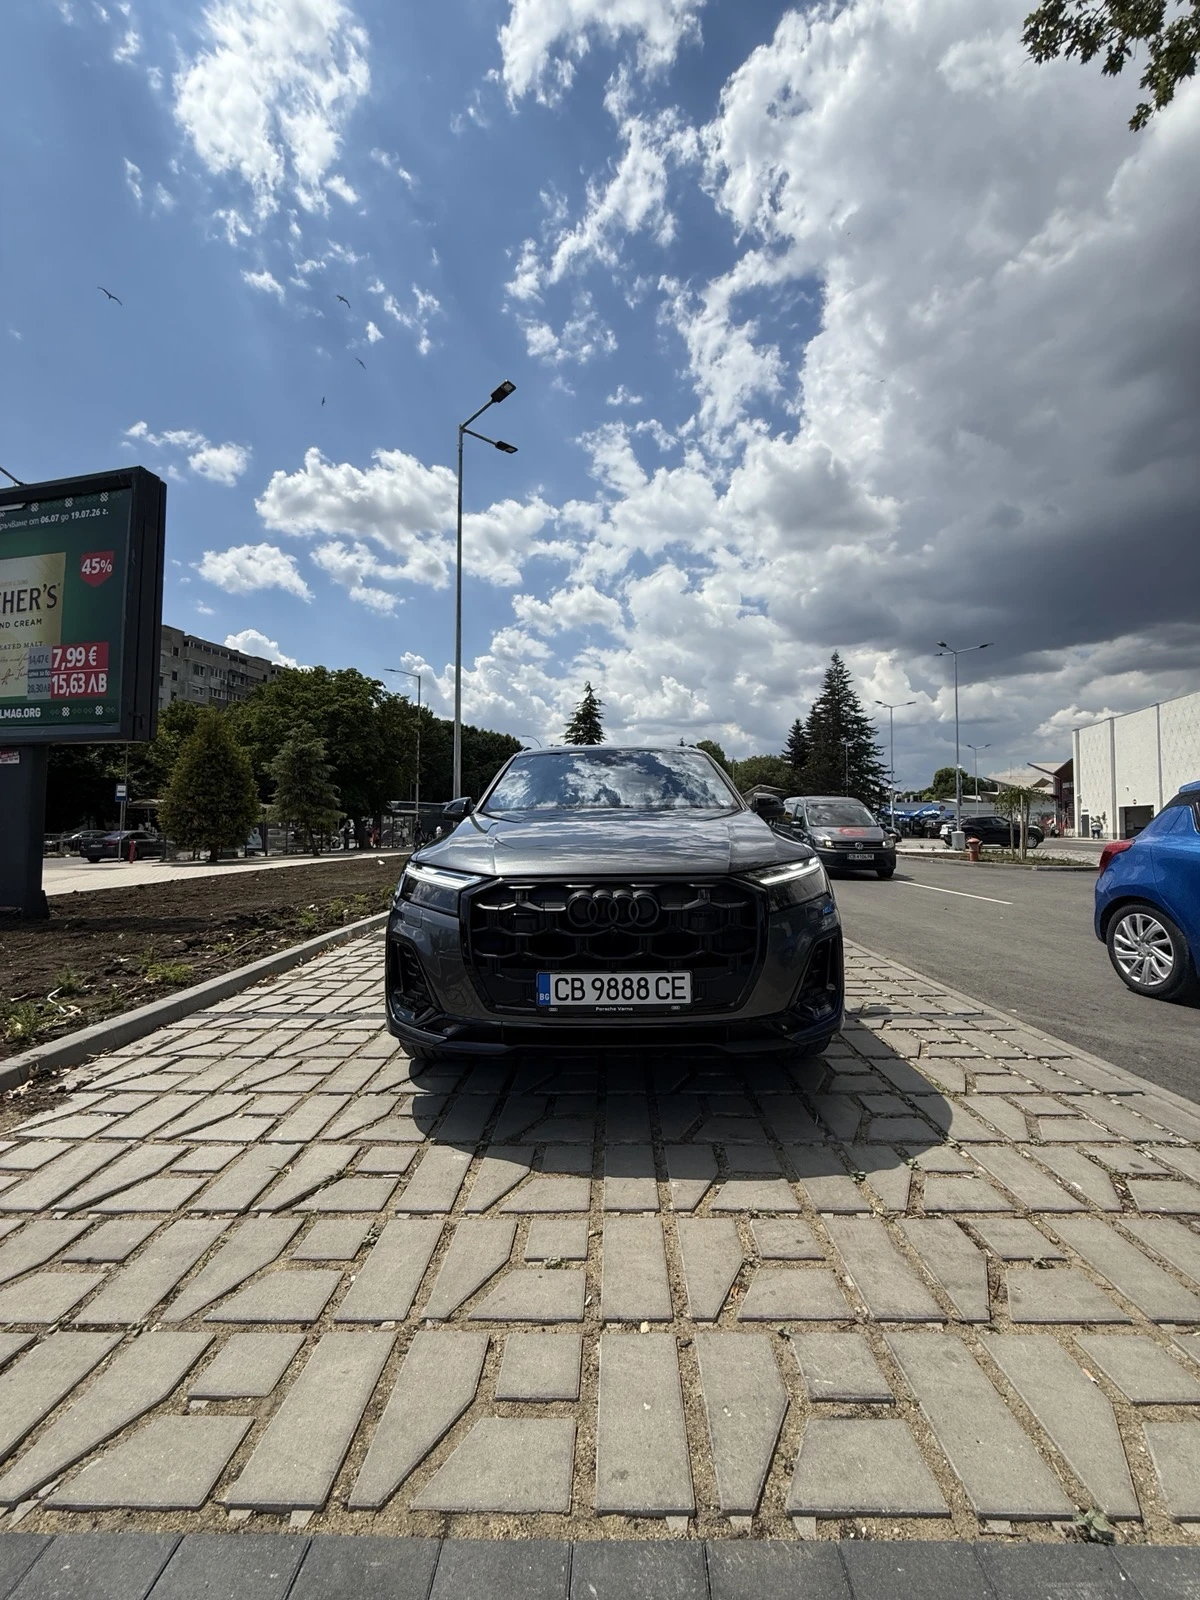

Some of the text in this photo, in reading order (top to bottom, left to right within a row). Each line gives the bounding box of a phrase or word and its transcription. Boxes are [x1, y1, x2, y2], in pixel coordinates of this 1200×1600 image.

[40, 514, 60, 524] 06.07
[60, 514, 69, 522] до
[71, 508, 100, 519] 19.07.26
[81, 557, 113, 575] 45%
[0, 583, 57, 614] HER'S
[14, 618, 42, 628] CREAM
[24, 641, 43, 649] MALT
[53, 647, 86, 671] 7,99
[88, 646, 97, 666] €
[52, 673, 86, 696] 15,63
[87, 673, 107, 693] ЛВ
[554, 977, 586, 1001] CB
[591, 976, 650, 1001] 9888
[655, 976, 687, 1000] CE
